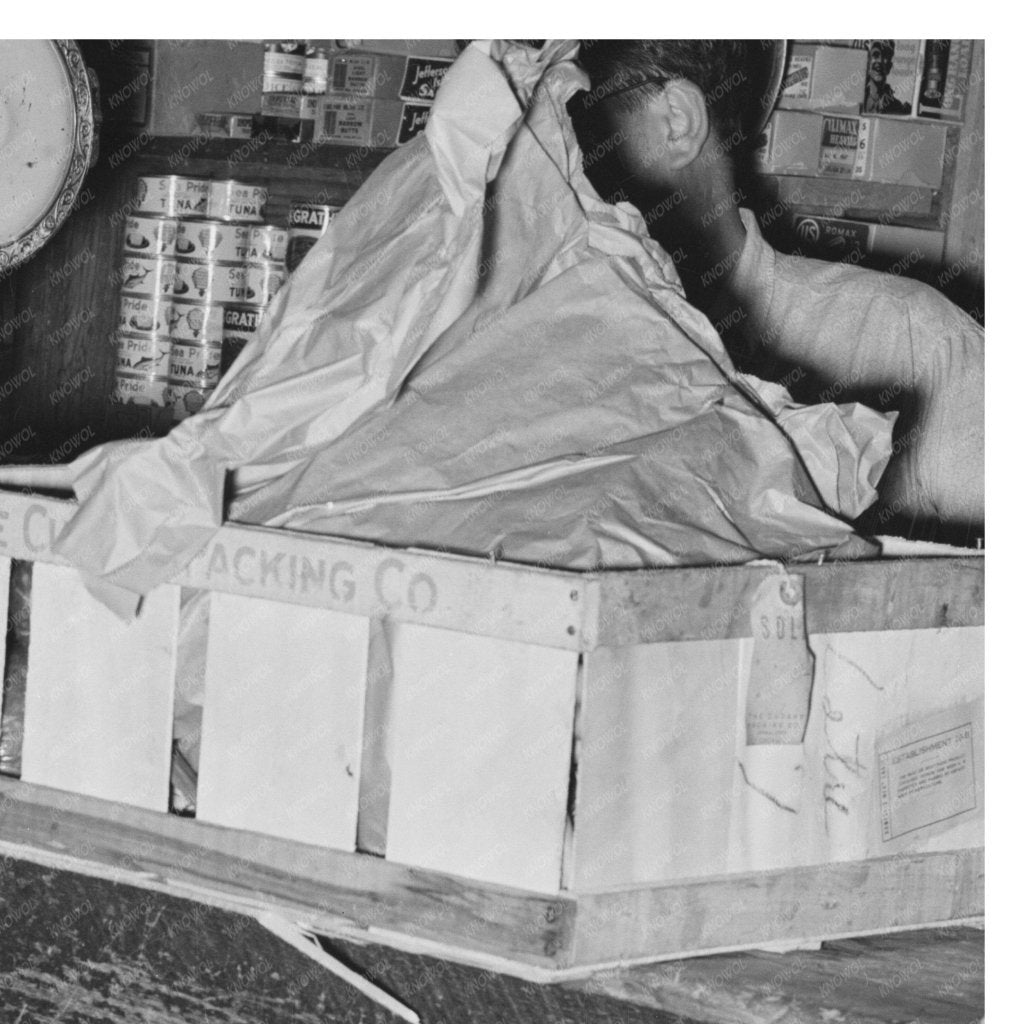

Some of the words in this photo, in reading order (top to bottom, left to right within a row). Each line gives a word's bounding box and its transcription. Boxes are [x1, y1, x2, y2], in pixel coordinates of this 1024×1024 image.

[859, 138, 866, 150] 6
[160, 198, 192, 209] TNA
[229, 204, 257, 215] TUNA
[293, 208, 329, 226] GRAT
[170, 363, 195, 376] TUNA
[187, 542, 356, 604] ACKING
